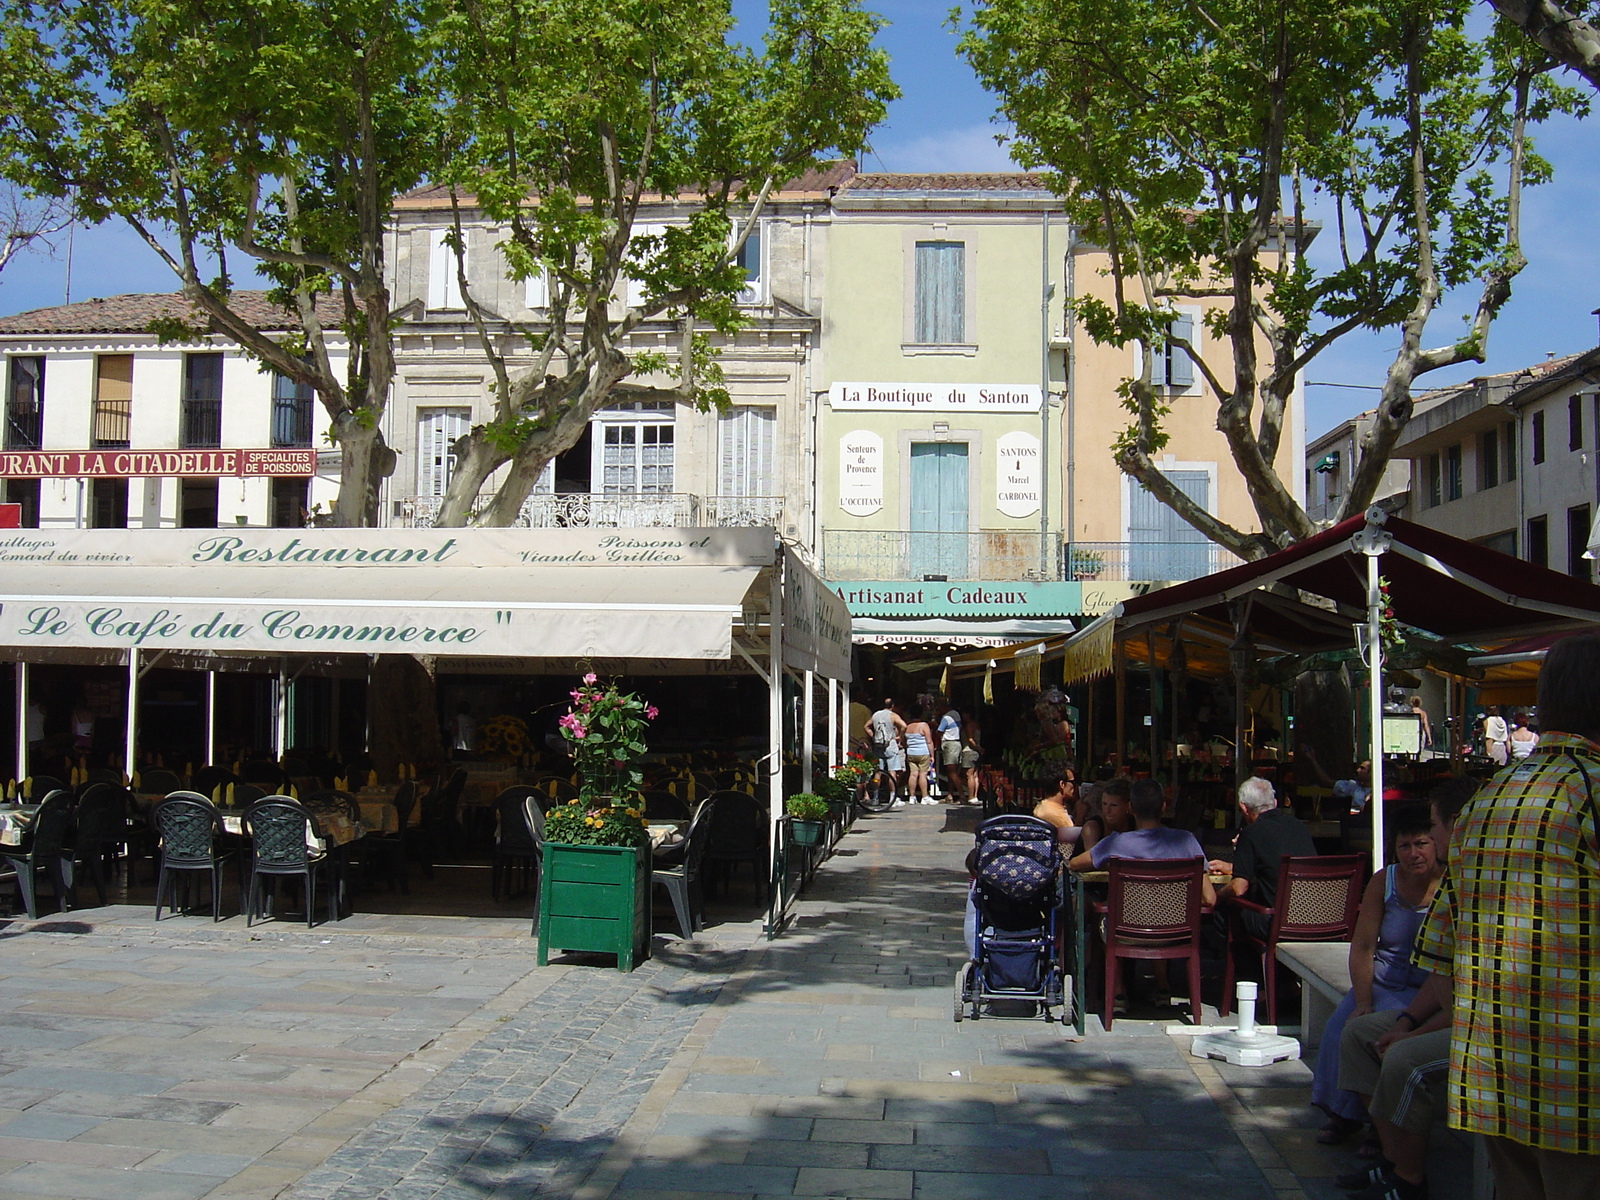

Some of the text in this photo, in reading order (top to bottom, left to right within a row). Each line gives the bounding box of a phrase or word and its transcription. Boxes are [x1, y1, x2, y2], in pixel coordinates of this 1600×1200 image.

[841, 387, 1030, 407] La Boutique du Santon
[846, 444, 877, 454] Senteurs
[1000, 447, 1037, 457] SANTONS
[249, 452, 310, 463] SPECIALITES
[857, 454, 866, 464] de
[77, 454, 107, 474] LA
[114, 453, 237, 474] CITADELLE
[245, 462, 312, 473] DE POISSONS
[846, 464, 877, 474] Provence
[1007, 475, 1030, 484] Marcel
[840, 497, 883, 506] L'OCCITANE
[998, 491, 1039, 501] CARBONEL
[598, 535, 712, 549] Poissons et
[191, 536, 459, 563] Restaurant
[57, 550, 81, 561] du
[85, 552, 134, 562] vivier
[518, 548, 687, 563] Viandes Grillées
[834, 586, 925, 604] Artisanat
[946, 586, 1028, 605] Cadeaux
[18, 606, 77, 636] Le
[85, 607, 188, 645] Café
[190, 611, 254, 639] du
[261, 609, 488, 644] Commerce
[874, 635, 941, 643] Boutique
[948, 635, 967, 644] du
